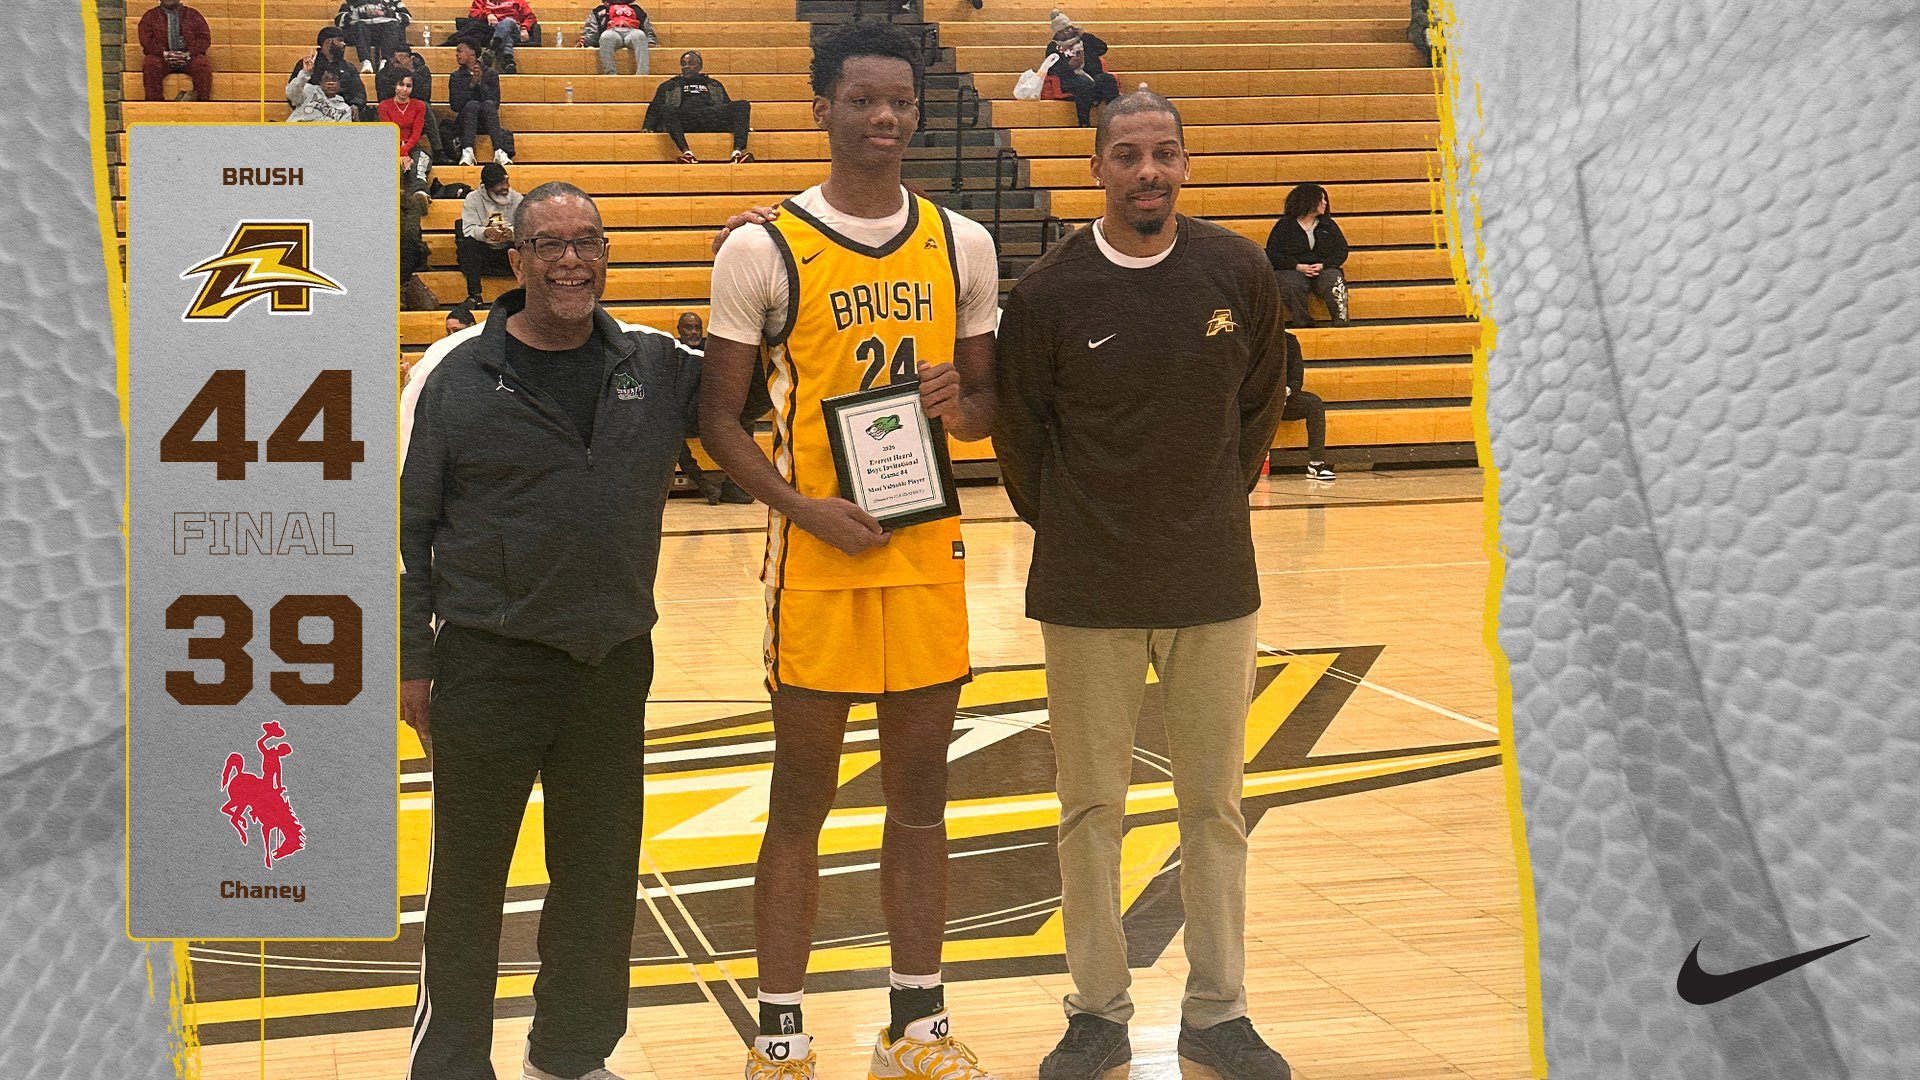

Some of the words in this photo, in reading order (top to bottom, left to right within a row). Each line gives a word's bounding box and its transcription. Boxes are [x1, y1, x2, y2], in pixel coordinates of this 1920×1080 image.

[829, 281, 933, 331] BRUSH
[855, 336, 919, 391] 24
[869, 457, 893, 466] Everett
[893, 452, 913, 461] Heard
[883, 459, 919, 472] Invitational
[880, 472, 900, 480] Game
[882, 481, 907, 490] Valuable
[907, 477, 925, 486] Player
